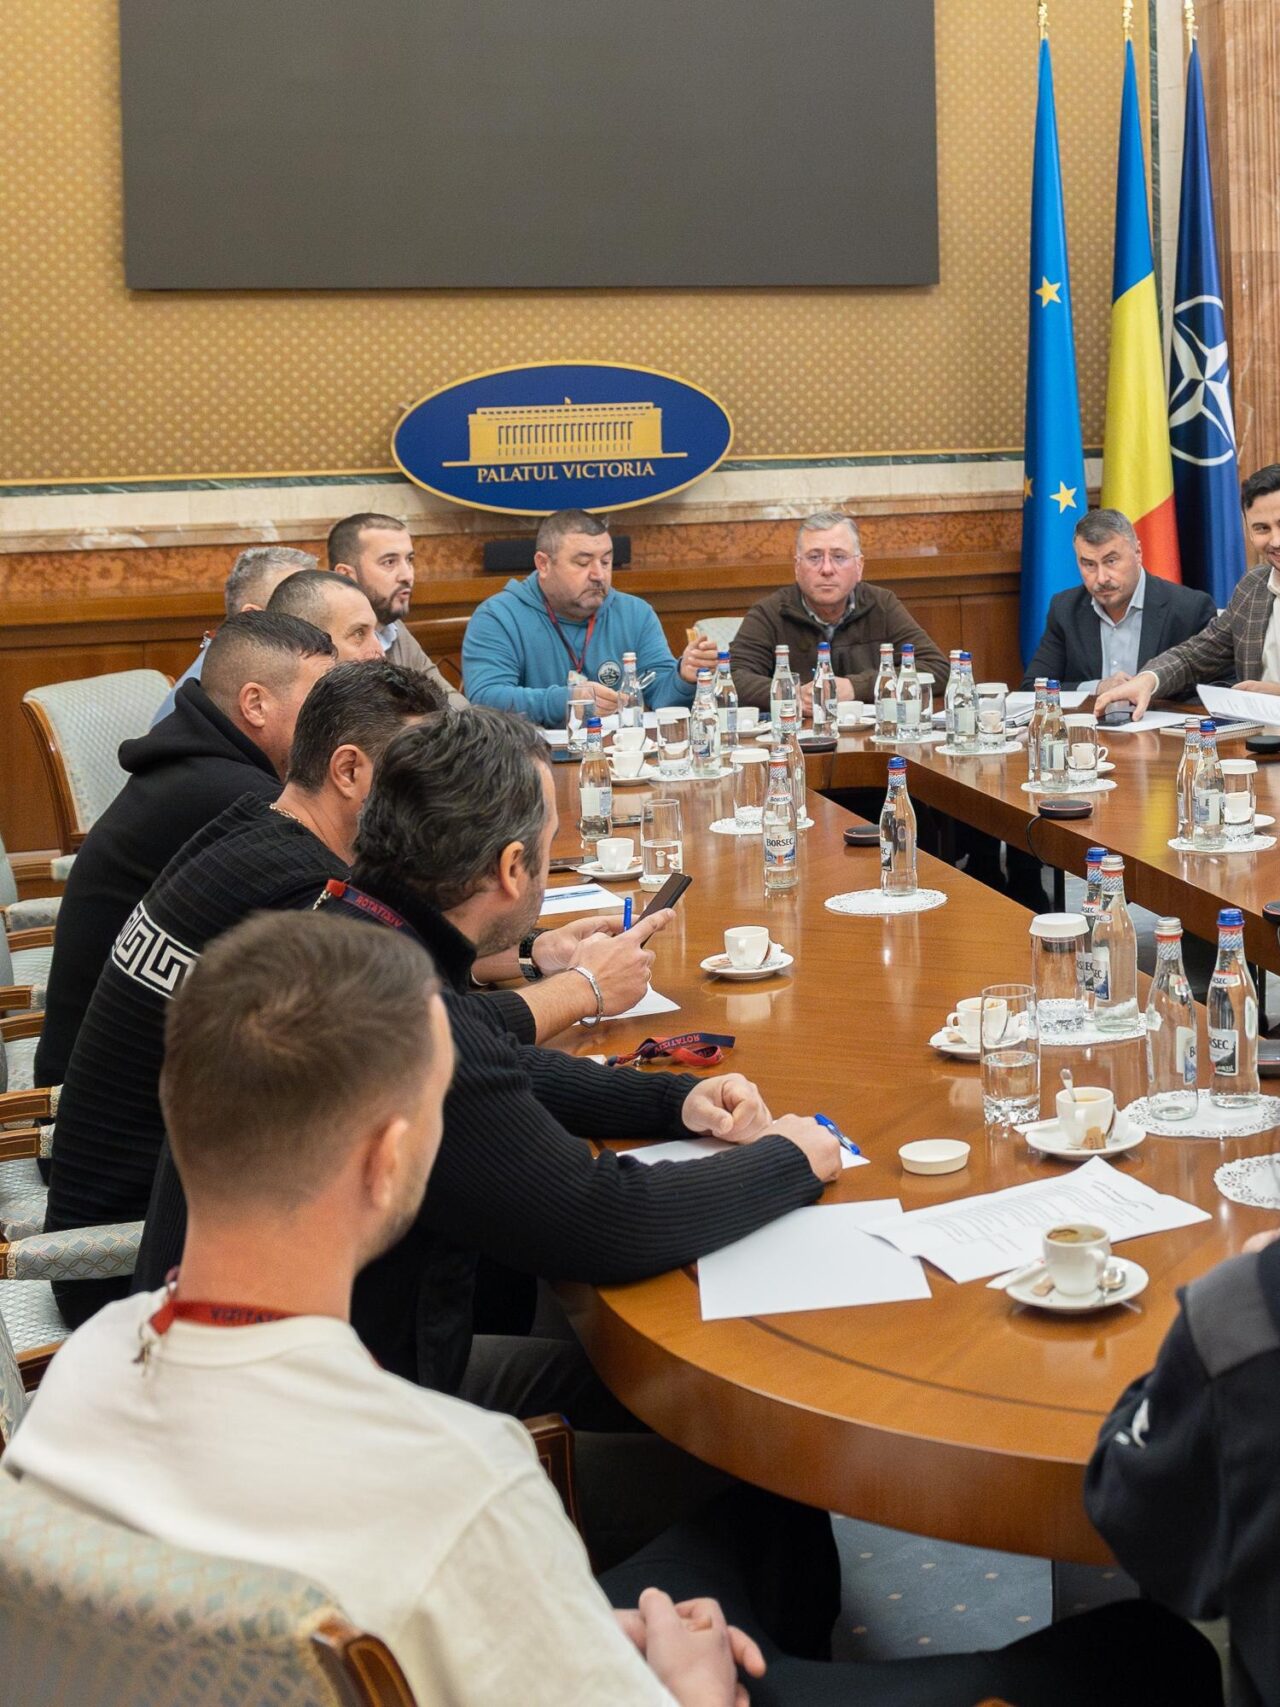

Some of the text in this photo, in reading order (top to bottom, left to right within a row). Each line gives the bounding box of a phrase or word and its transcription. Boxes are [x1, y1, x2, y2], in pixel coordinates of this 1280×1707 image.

[477, 461, 656, 483] PALATUL VICTORIA
[766, 838, 793, 847] BORSEC
